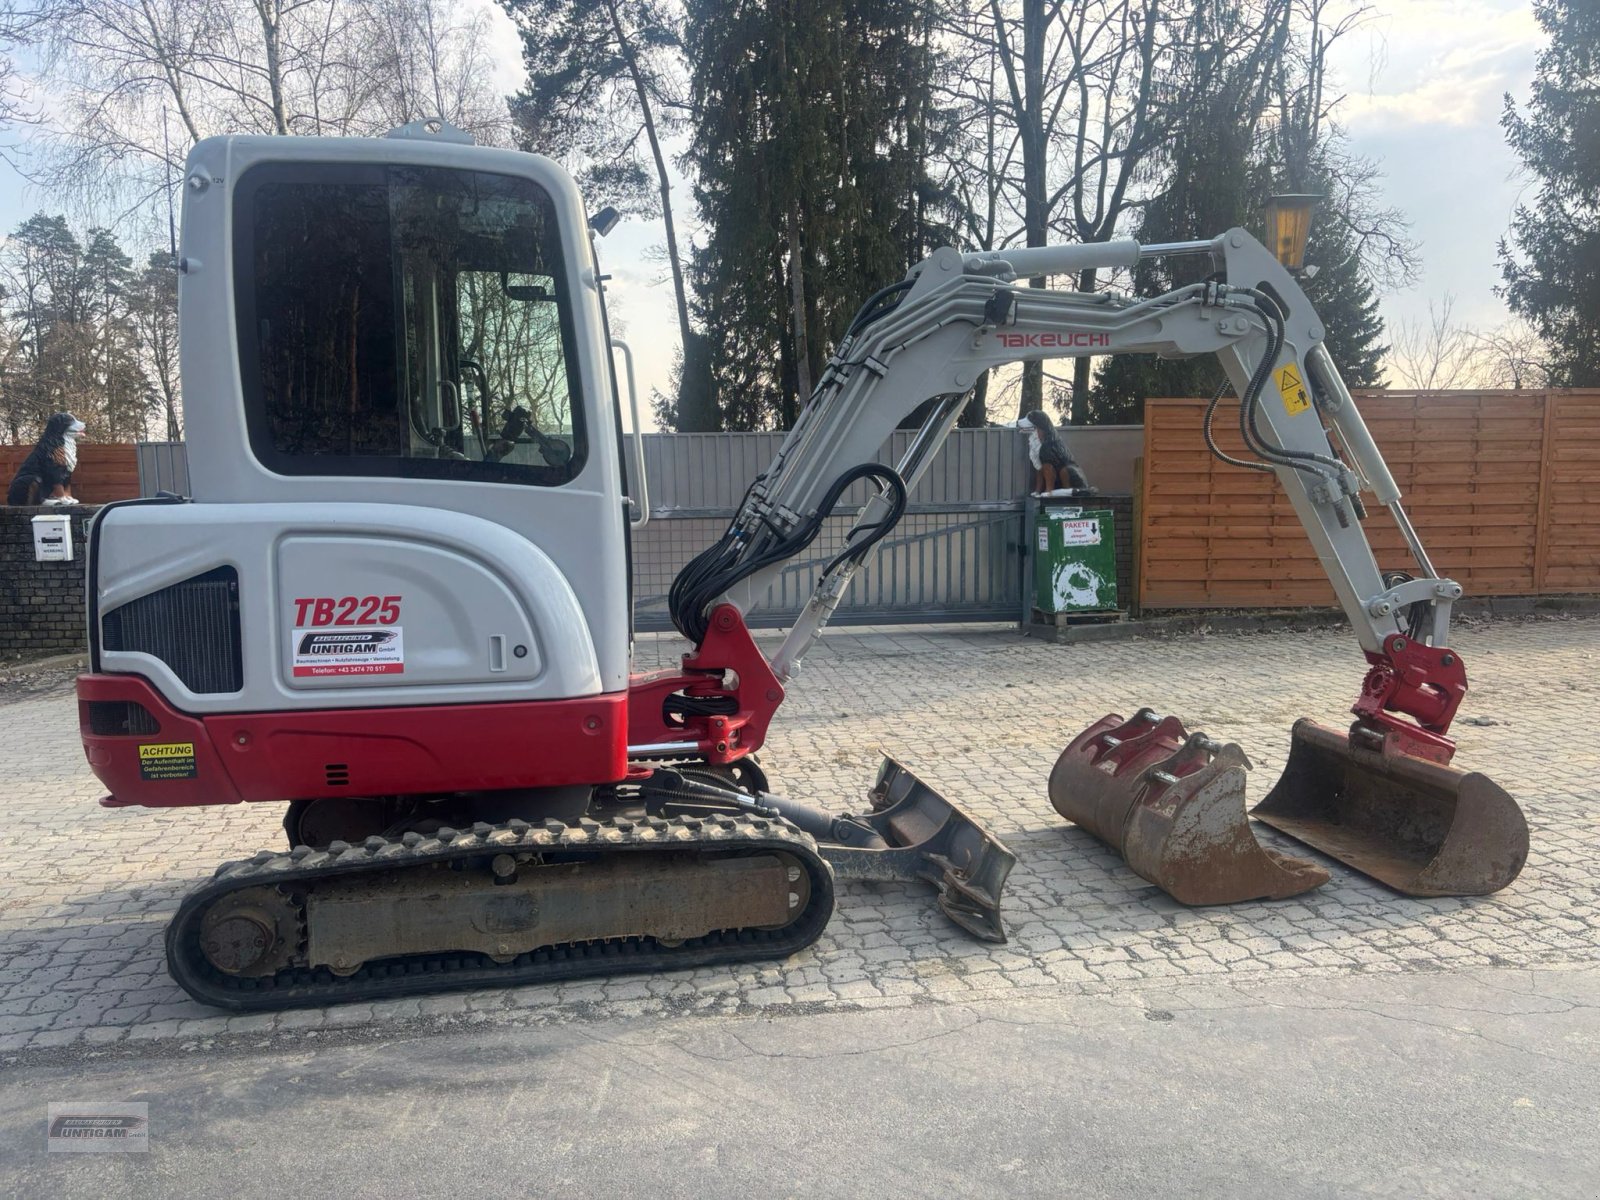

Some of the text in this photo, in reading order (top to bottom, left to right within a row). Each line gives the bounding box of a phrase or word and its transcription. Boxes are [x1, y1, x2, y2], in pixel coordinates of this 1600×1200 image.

[996, 334, 1110, 348] TAKEUCHI
[294, 596, 402, 627] TB225
[142, 746, 192, 756] ACHTUNG
